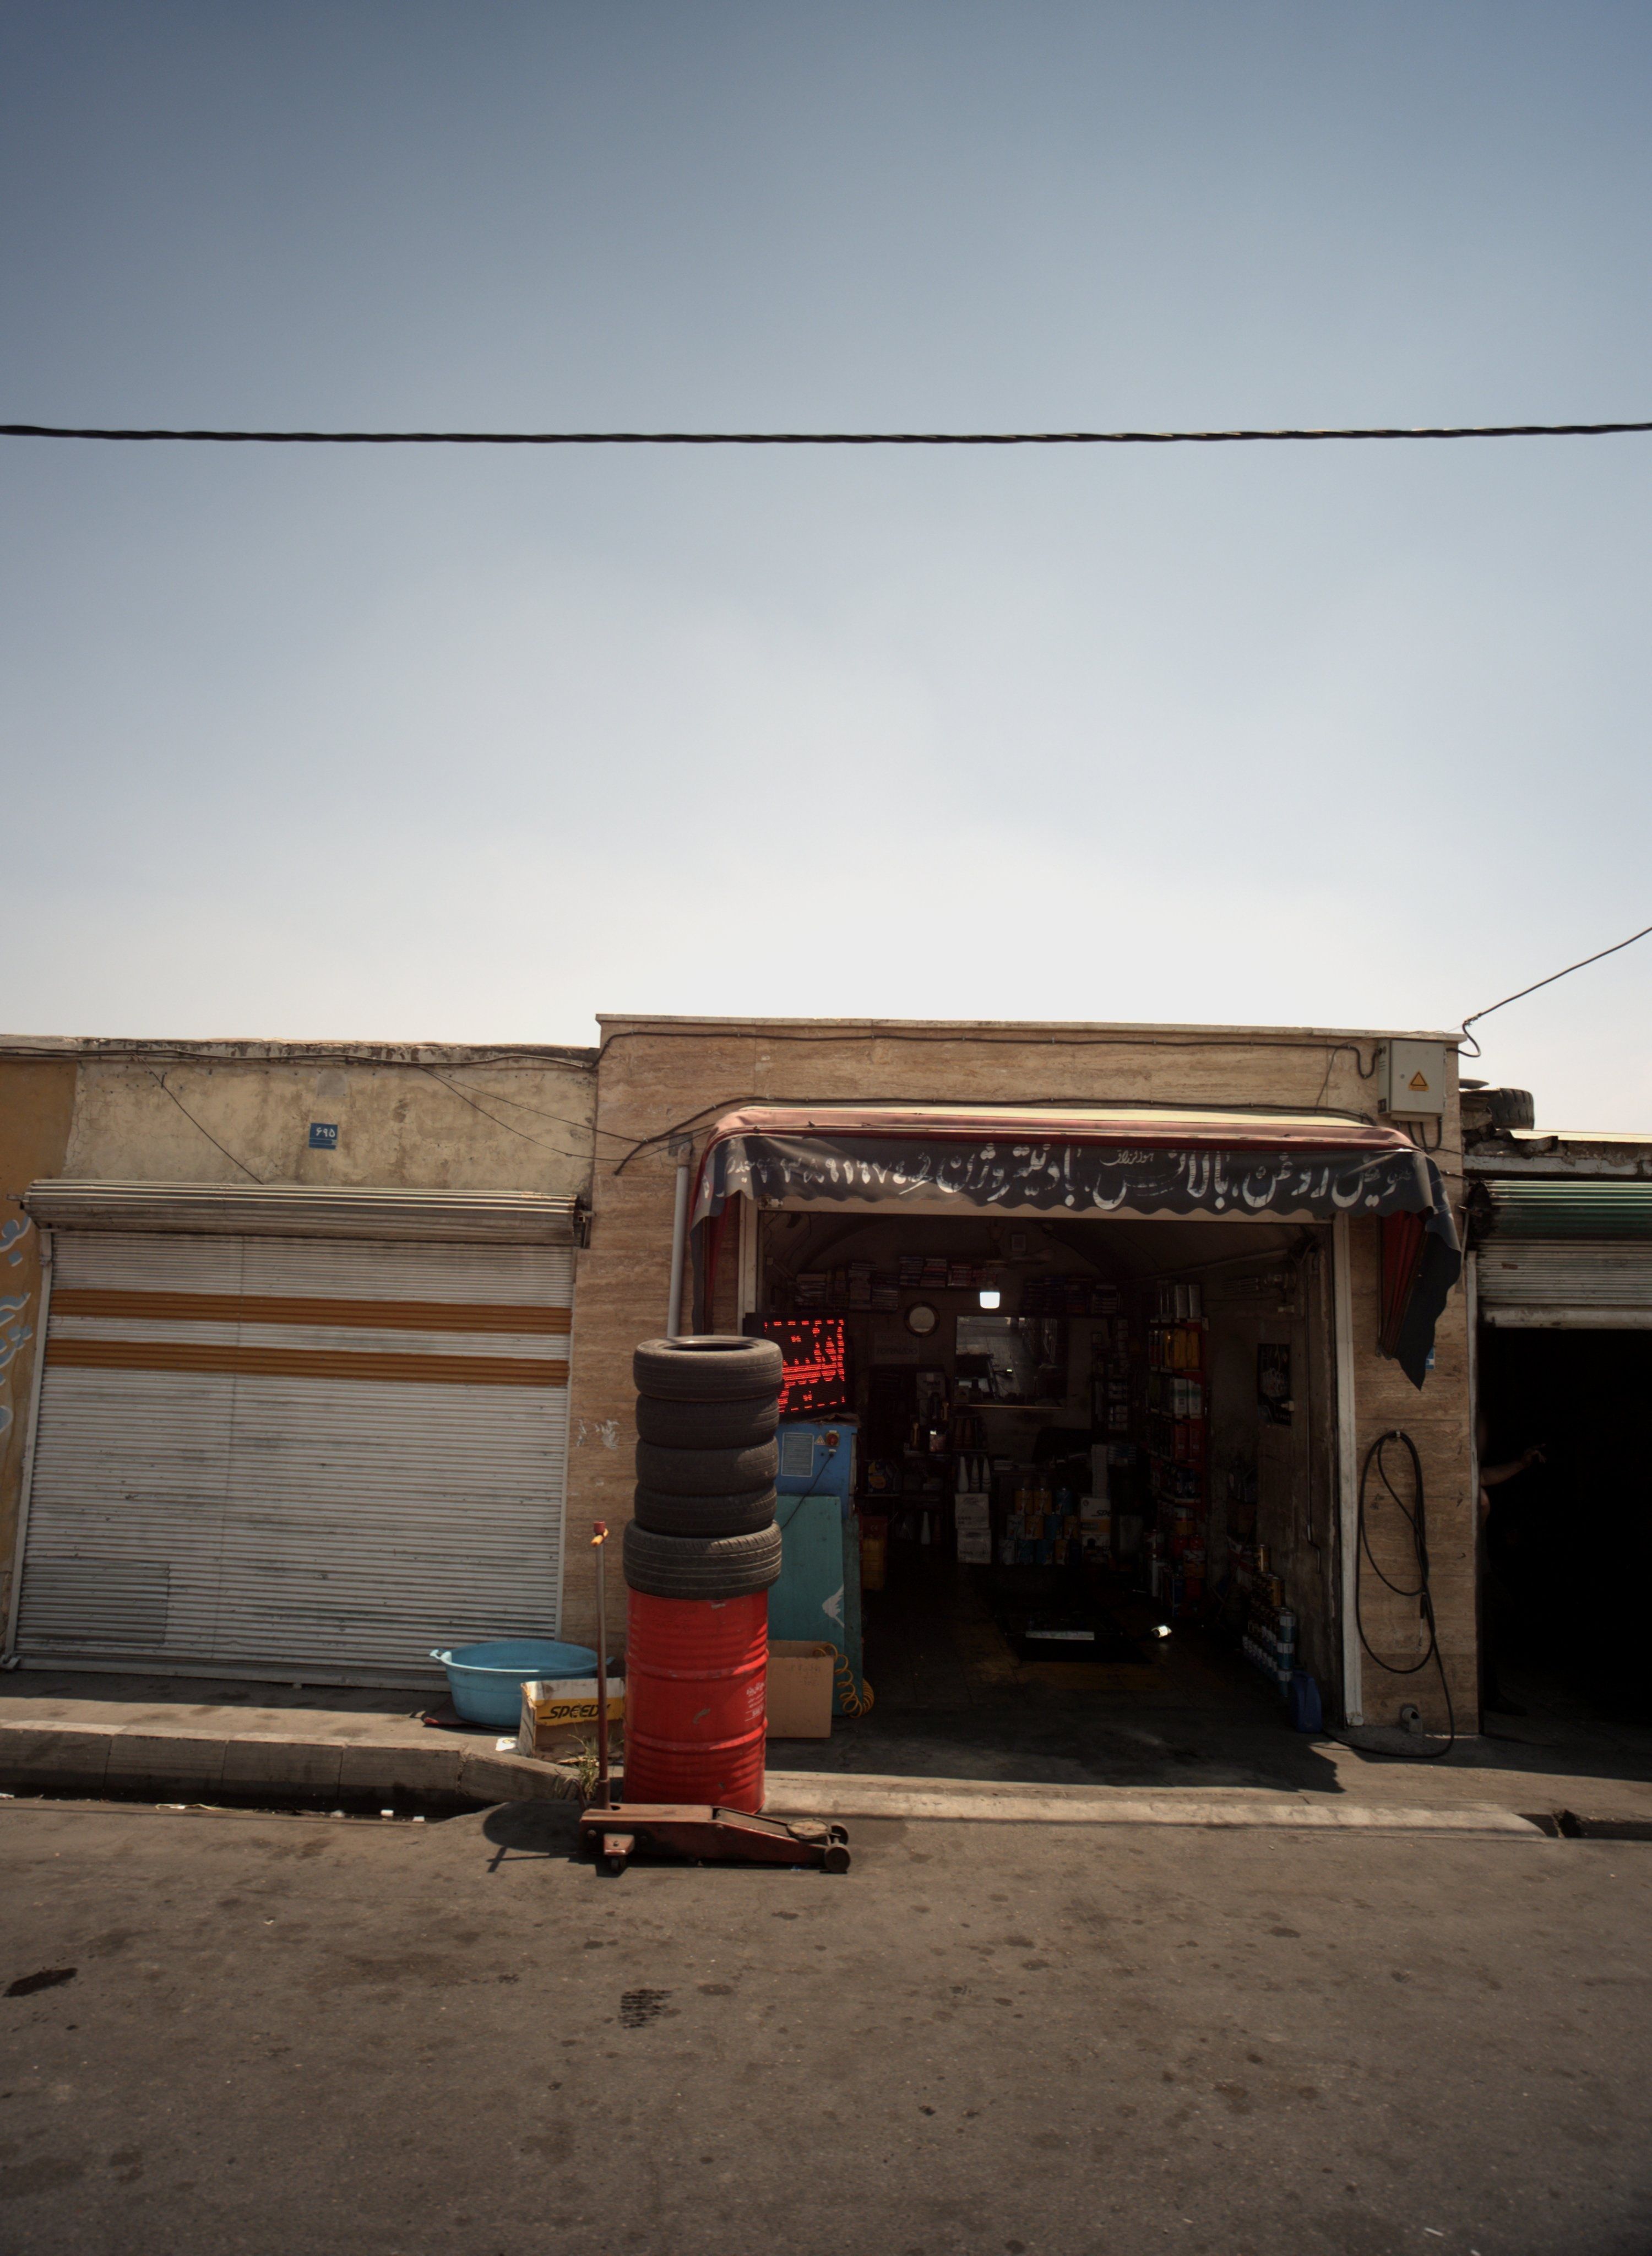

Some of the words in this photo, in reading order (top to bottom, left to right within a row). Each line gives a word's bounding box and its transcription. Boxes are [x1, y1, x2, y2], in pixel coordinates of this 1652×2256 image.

[316, 1127, 336, 1137] ۶۹۵
[937, 1142, 1051, 1201] نیتروژن
[1242, 1152, 1329, 1208] روغن
